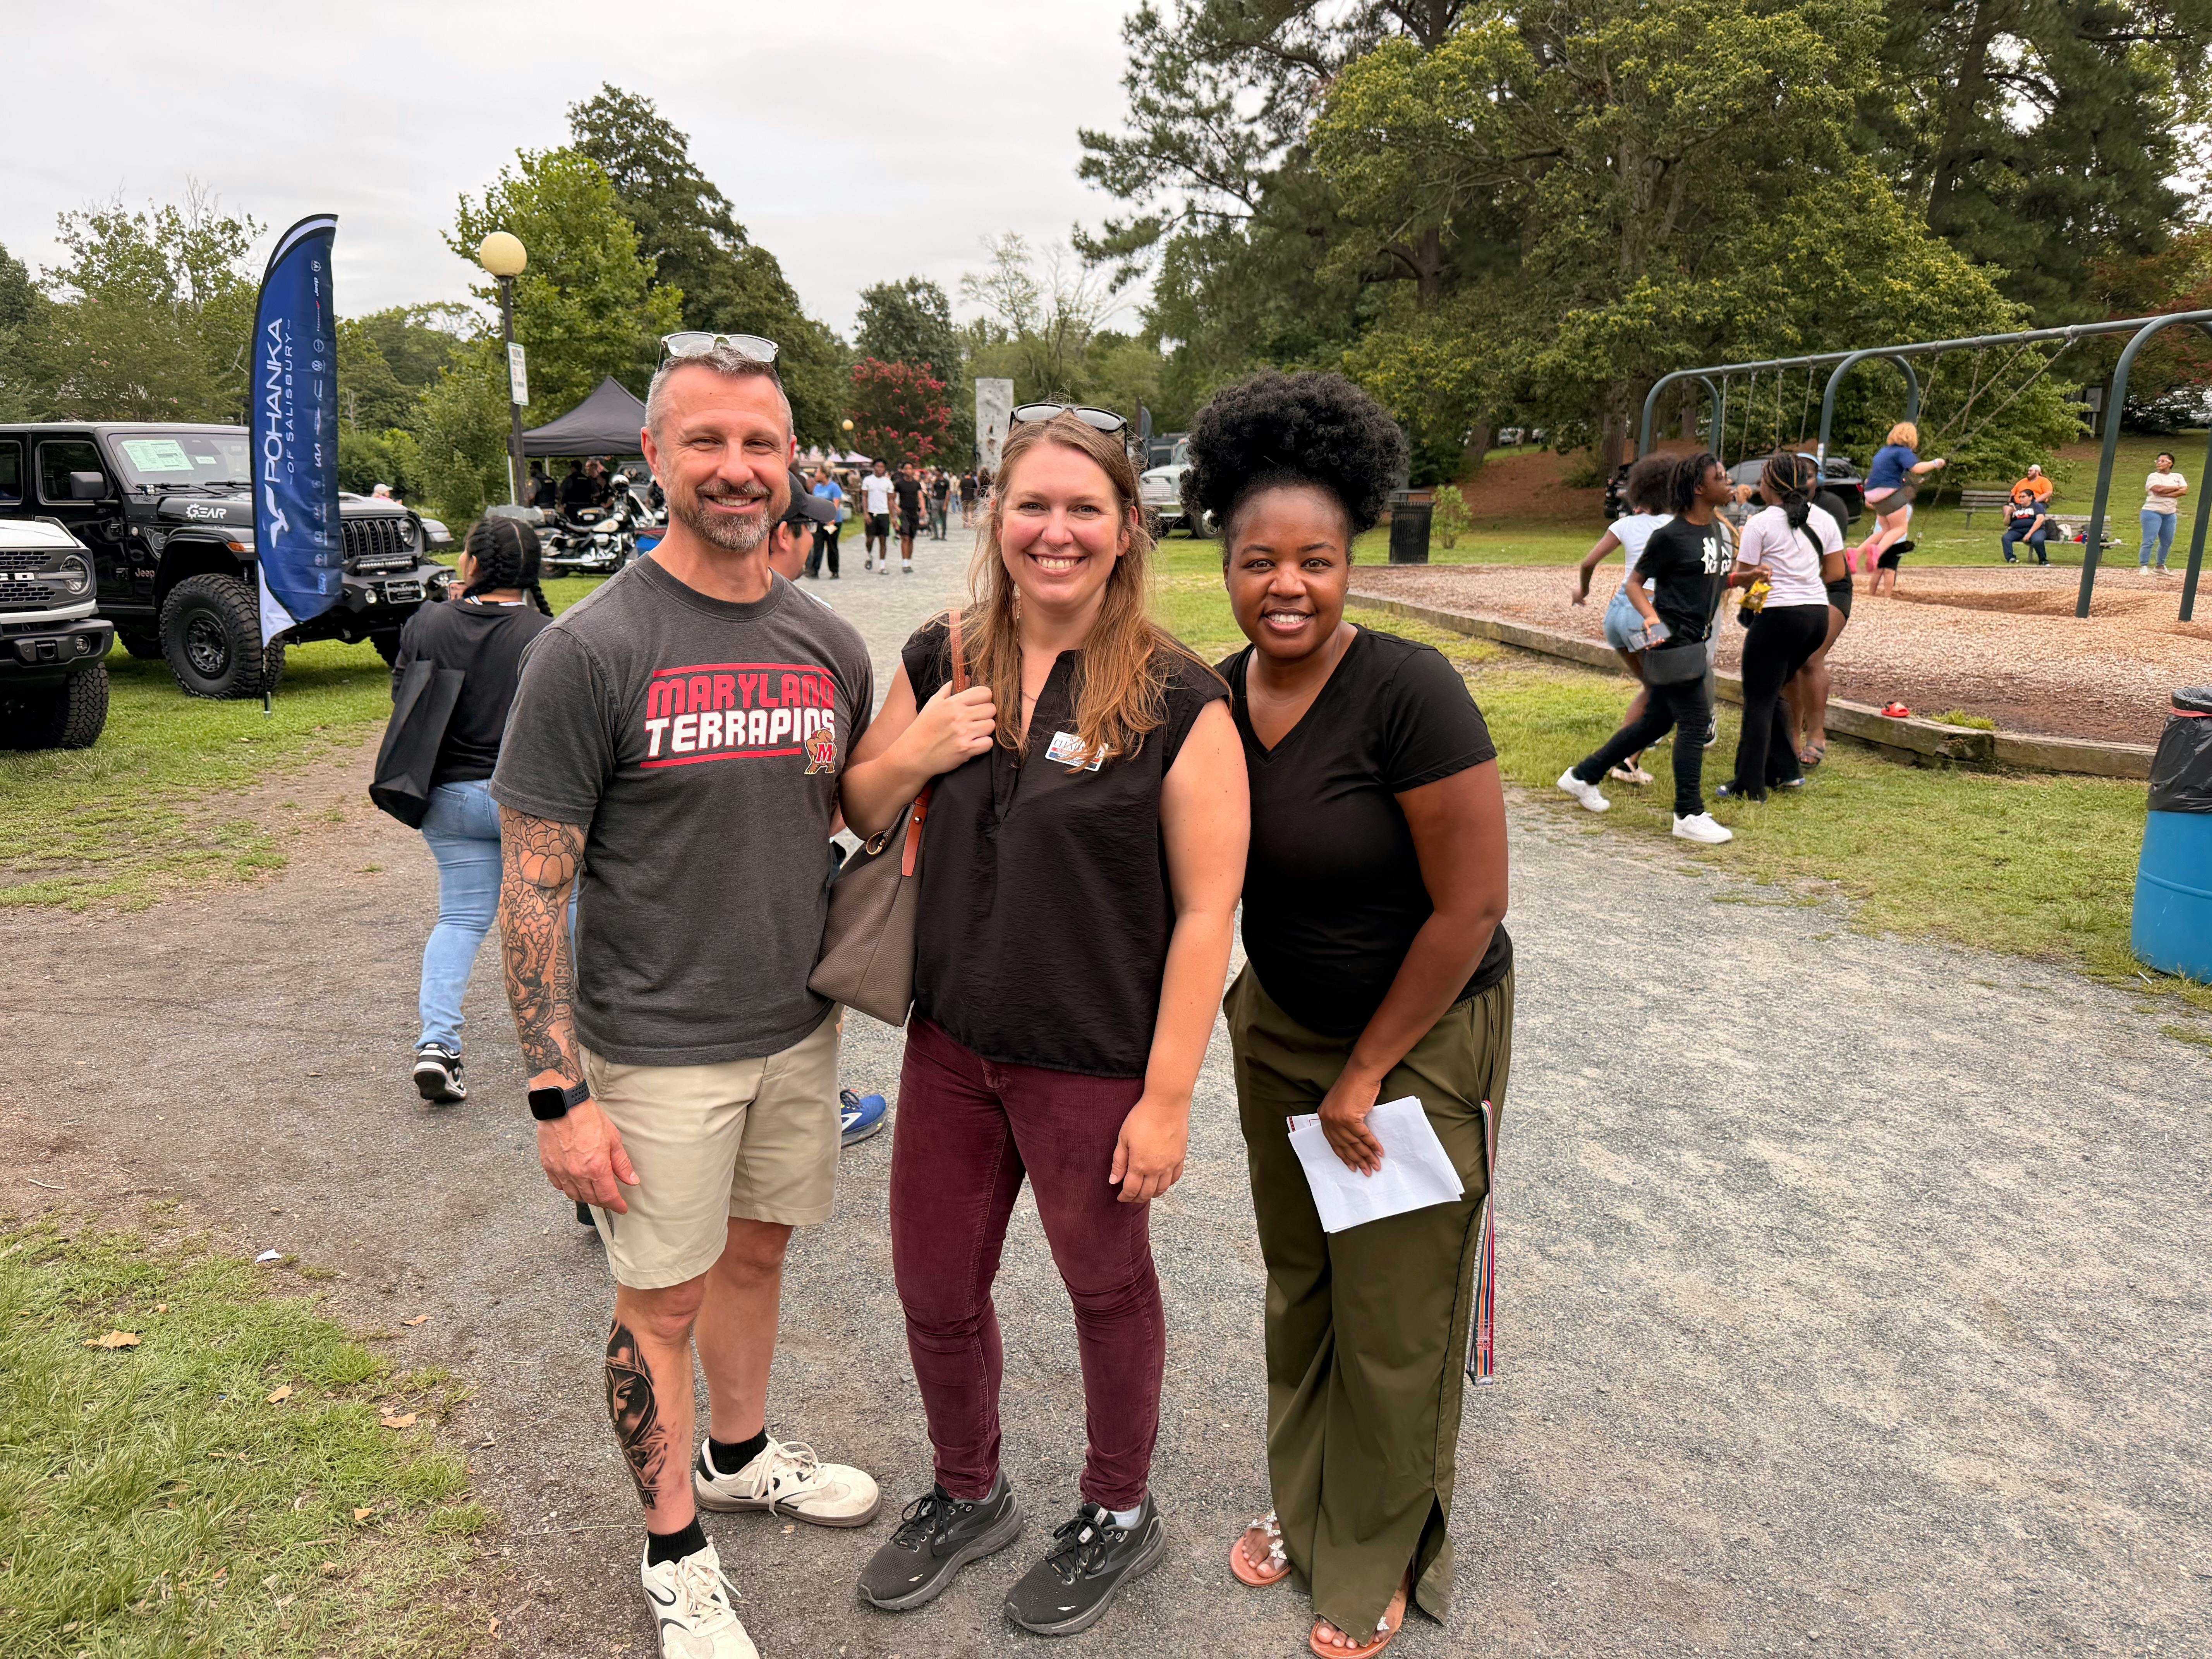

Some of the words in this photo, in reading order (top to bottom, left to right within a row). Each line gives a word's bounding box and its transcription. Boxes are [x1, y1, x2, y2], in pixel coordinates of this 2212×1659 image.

[264, 318, 283, 483] POHANKA
[285, 334, 294, 443] SALISBURY
[287, 450, 294, 472] OF
[135, 568, 155, 579] Jeep
[646, 673, 835, 719] MARYLAND
[644, 708, 835, 758] TERRAPINS
[815, 742, 833, 764] M
[937, 1528, 953, 1543] BROKS
